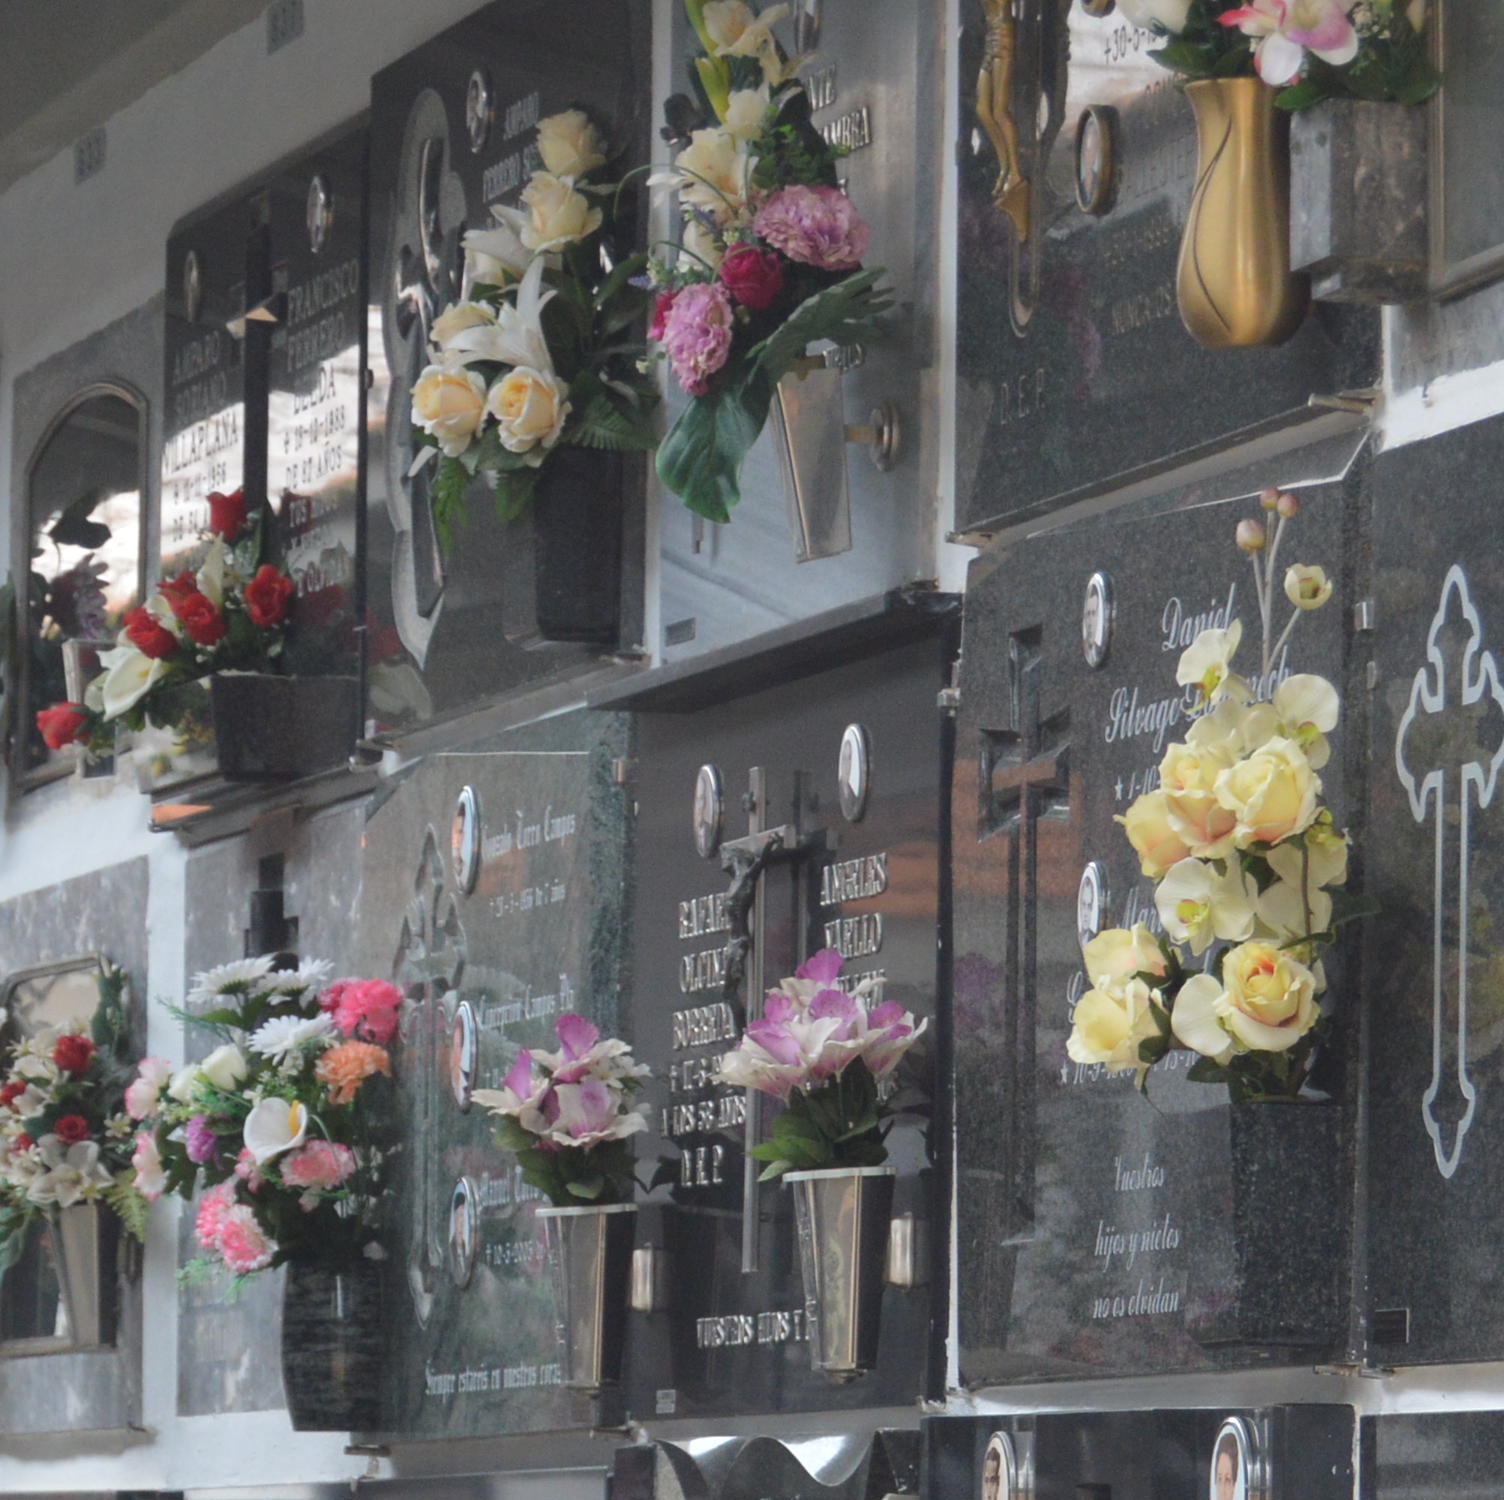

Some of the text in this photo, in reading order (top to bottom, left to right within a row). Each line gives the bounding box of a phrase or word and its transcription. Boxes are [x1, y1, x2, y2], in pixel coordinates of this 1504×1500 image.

[162, 411, 238, 474] VILLAPLANA
[820, 853, 887, 906] ANGELES
[1095, 1213, 1180, 1273] hijos y nietos
[1093, 1278, 1180, 1319] no os olvidan
